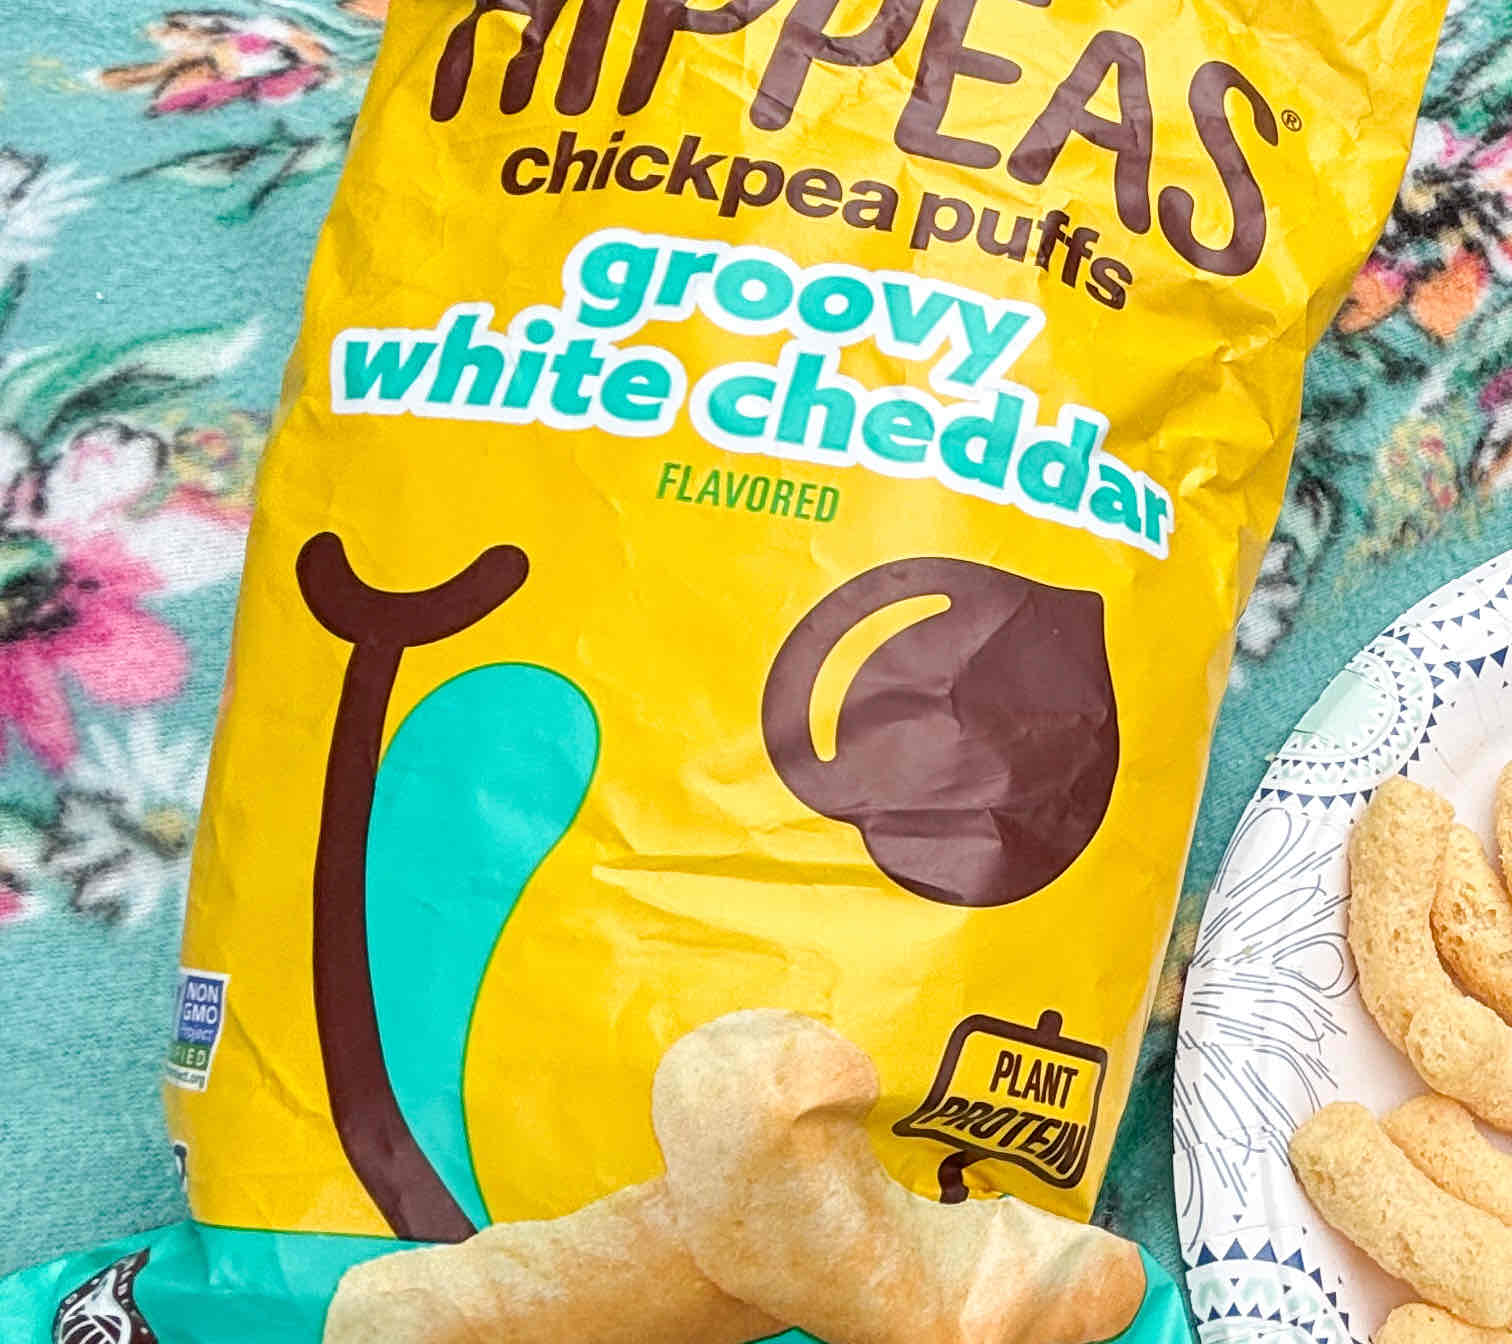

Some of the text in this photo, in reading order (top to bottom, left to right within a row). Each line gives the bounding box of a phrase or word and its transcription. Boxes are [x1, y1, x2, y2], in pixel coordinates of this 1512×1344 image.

[501, 129, 1133, 311] chickpea puffs
[576, 236, 1031, 386] groovy
[341, 314, 1170, 545] white cheddar
[656, 461, 841, 524] FLAVORED
[183, 1003, 218, 1024] GMO
[187, 981, 219, 1002] NON
[989, 1049, 1079, 1109] PLANT
[916, 1095, 1087, 1175] PROTEIN
